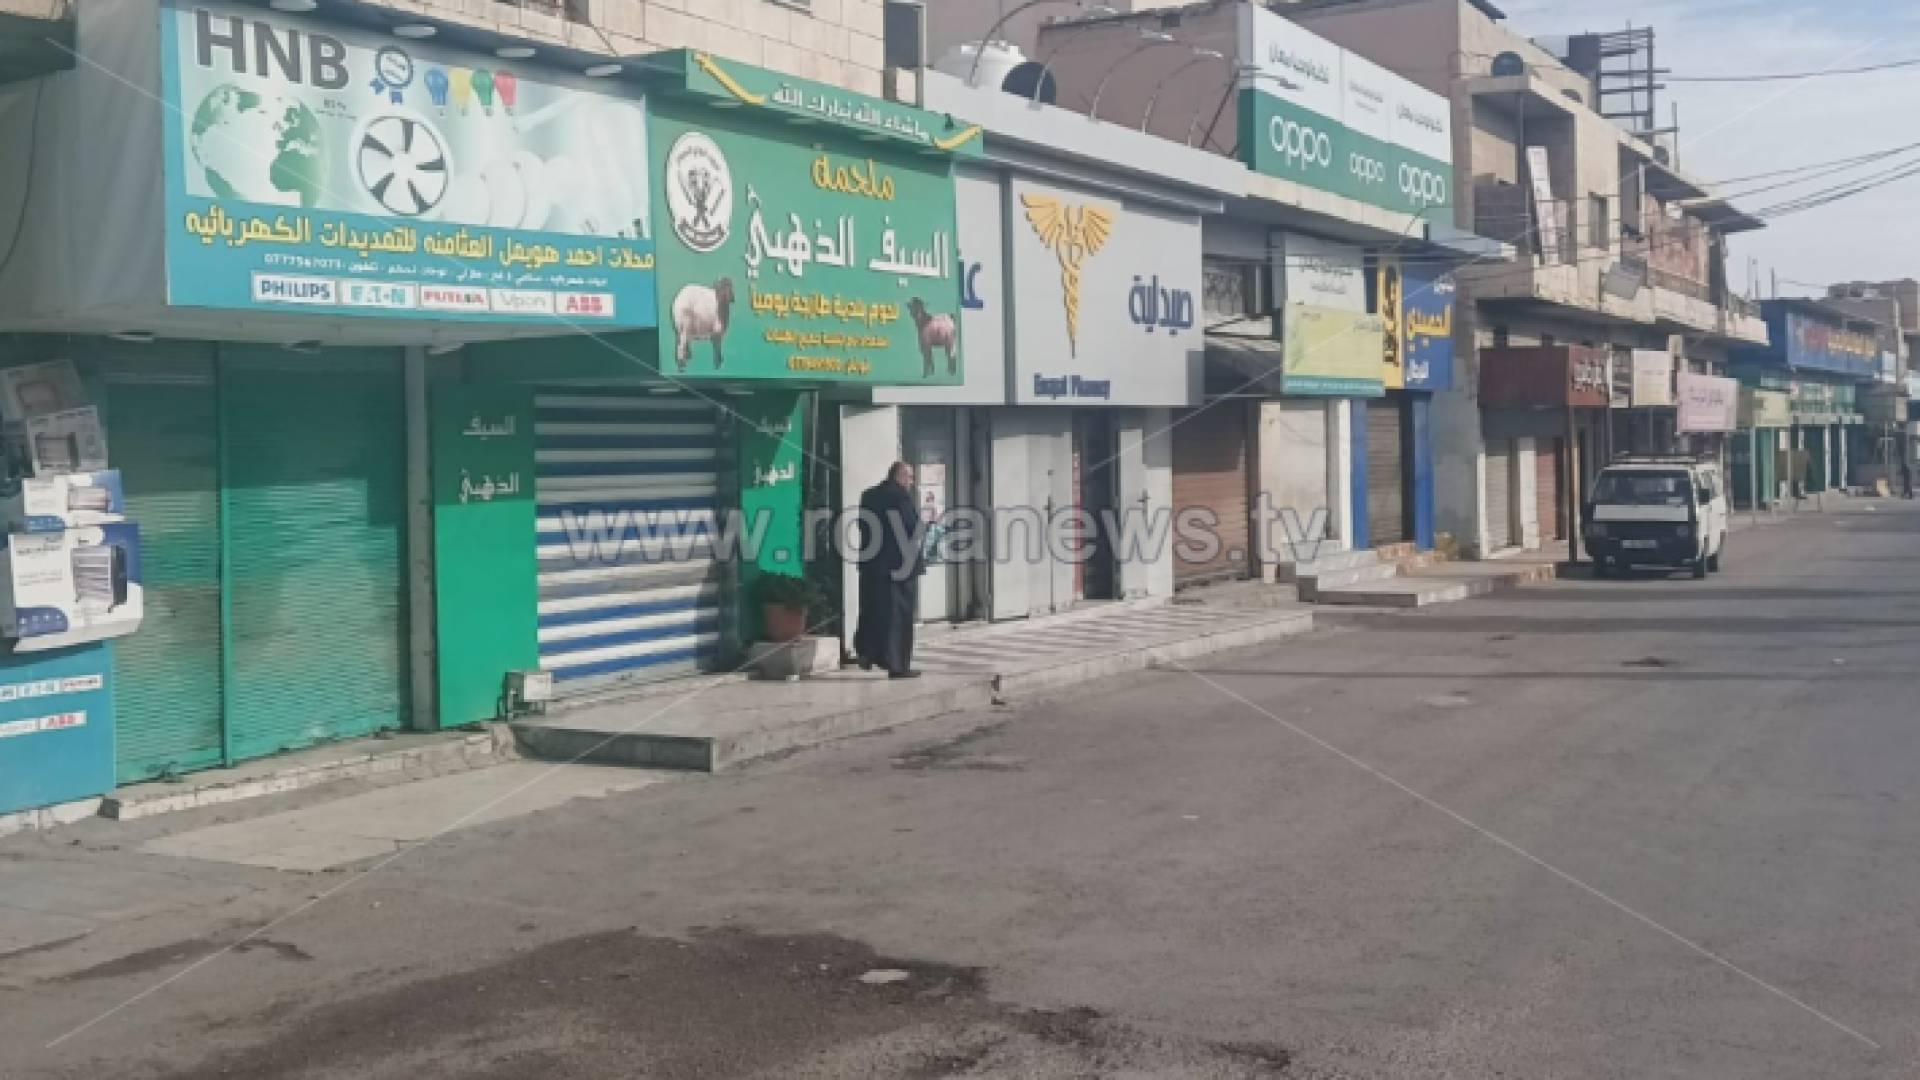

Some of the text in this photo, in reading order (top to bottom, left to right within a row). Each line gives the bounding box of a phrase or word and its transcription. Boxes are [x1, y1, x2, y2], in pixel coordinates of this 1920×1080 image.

[193, 9, 350, 91] HNB
[1270, 115, 1331, 171] oppo
[811, 154, 895, 201] ملحمة
[1350, 152, 1385, 184] oppo
[1399, 161, 1446, 208] oppo
[745, 182, 854, 280] الذهبي
[869, 215, 949, 288] السيف
[565, 245, 603, 267] احمد
[261, 279, 330, 299] PHILIPS
[566, 294, 603, 313] ABB
[1128, 274, 1194, 336] صيدلية
[462, 411, 517, 441] السيف
[459, 468, 519, 505] الذهبي
